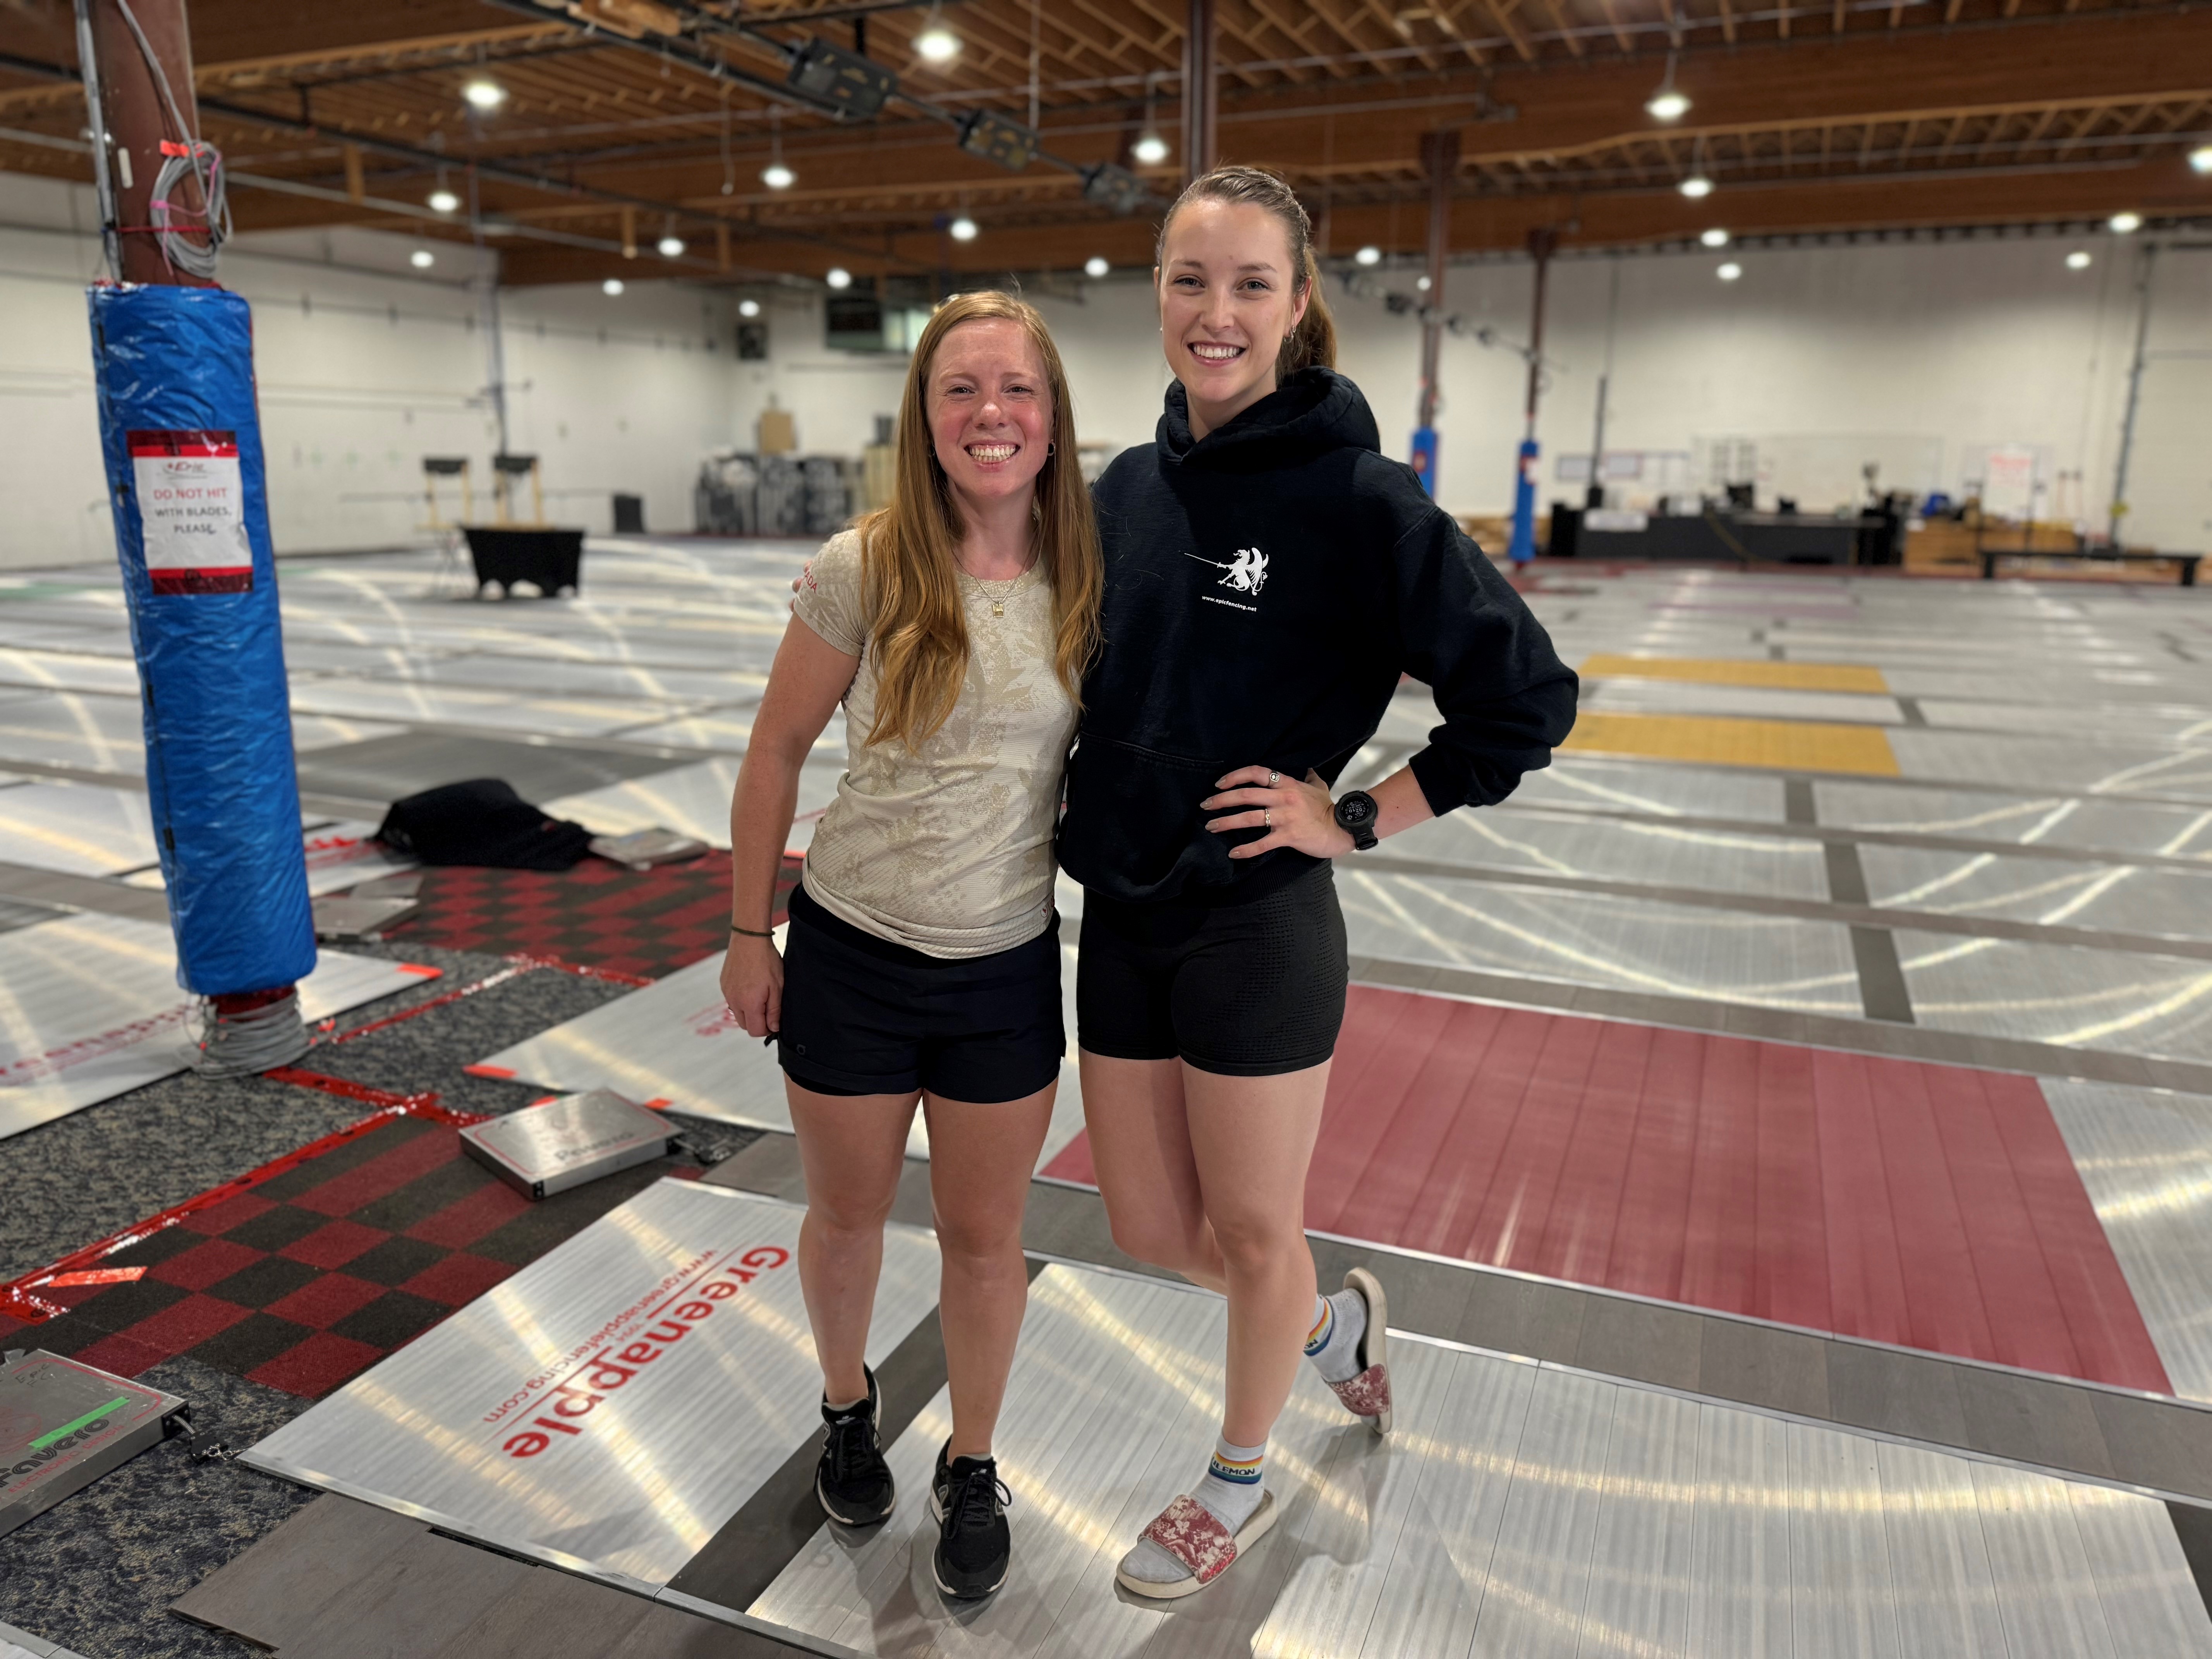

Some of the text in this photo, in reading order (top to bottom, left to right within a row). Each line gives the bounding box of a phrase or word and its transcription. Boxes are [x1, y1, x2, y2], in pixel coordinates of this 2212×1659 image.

[154, 487, 227, 500] DO NOT HIT
[155, 507, 183, 517] WITH
[1202, 596, 1257, 612] www.epicfencing.net
[483, 1249, 718, 1423] www.greenapplefencing.com
[502, 1245, 790, 1459] Greenapple
[82, 1425, 125, 1449] DESIGN
